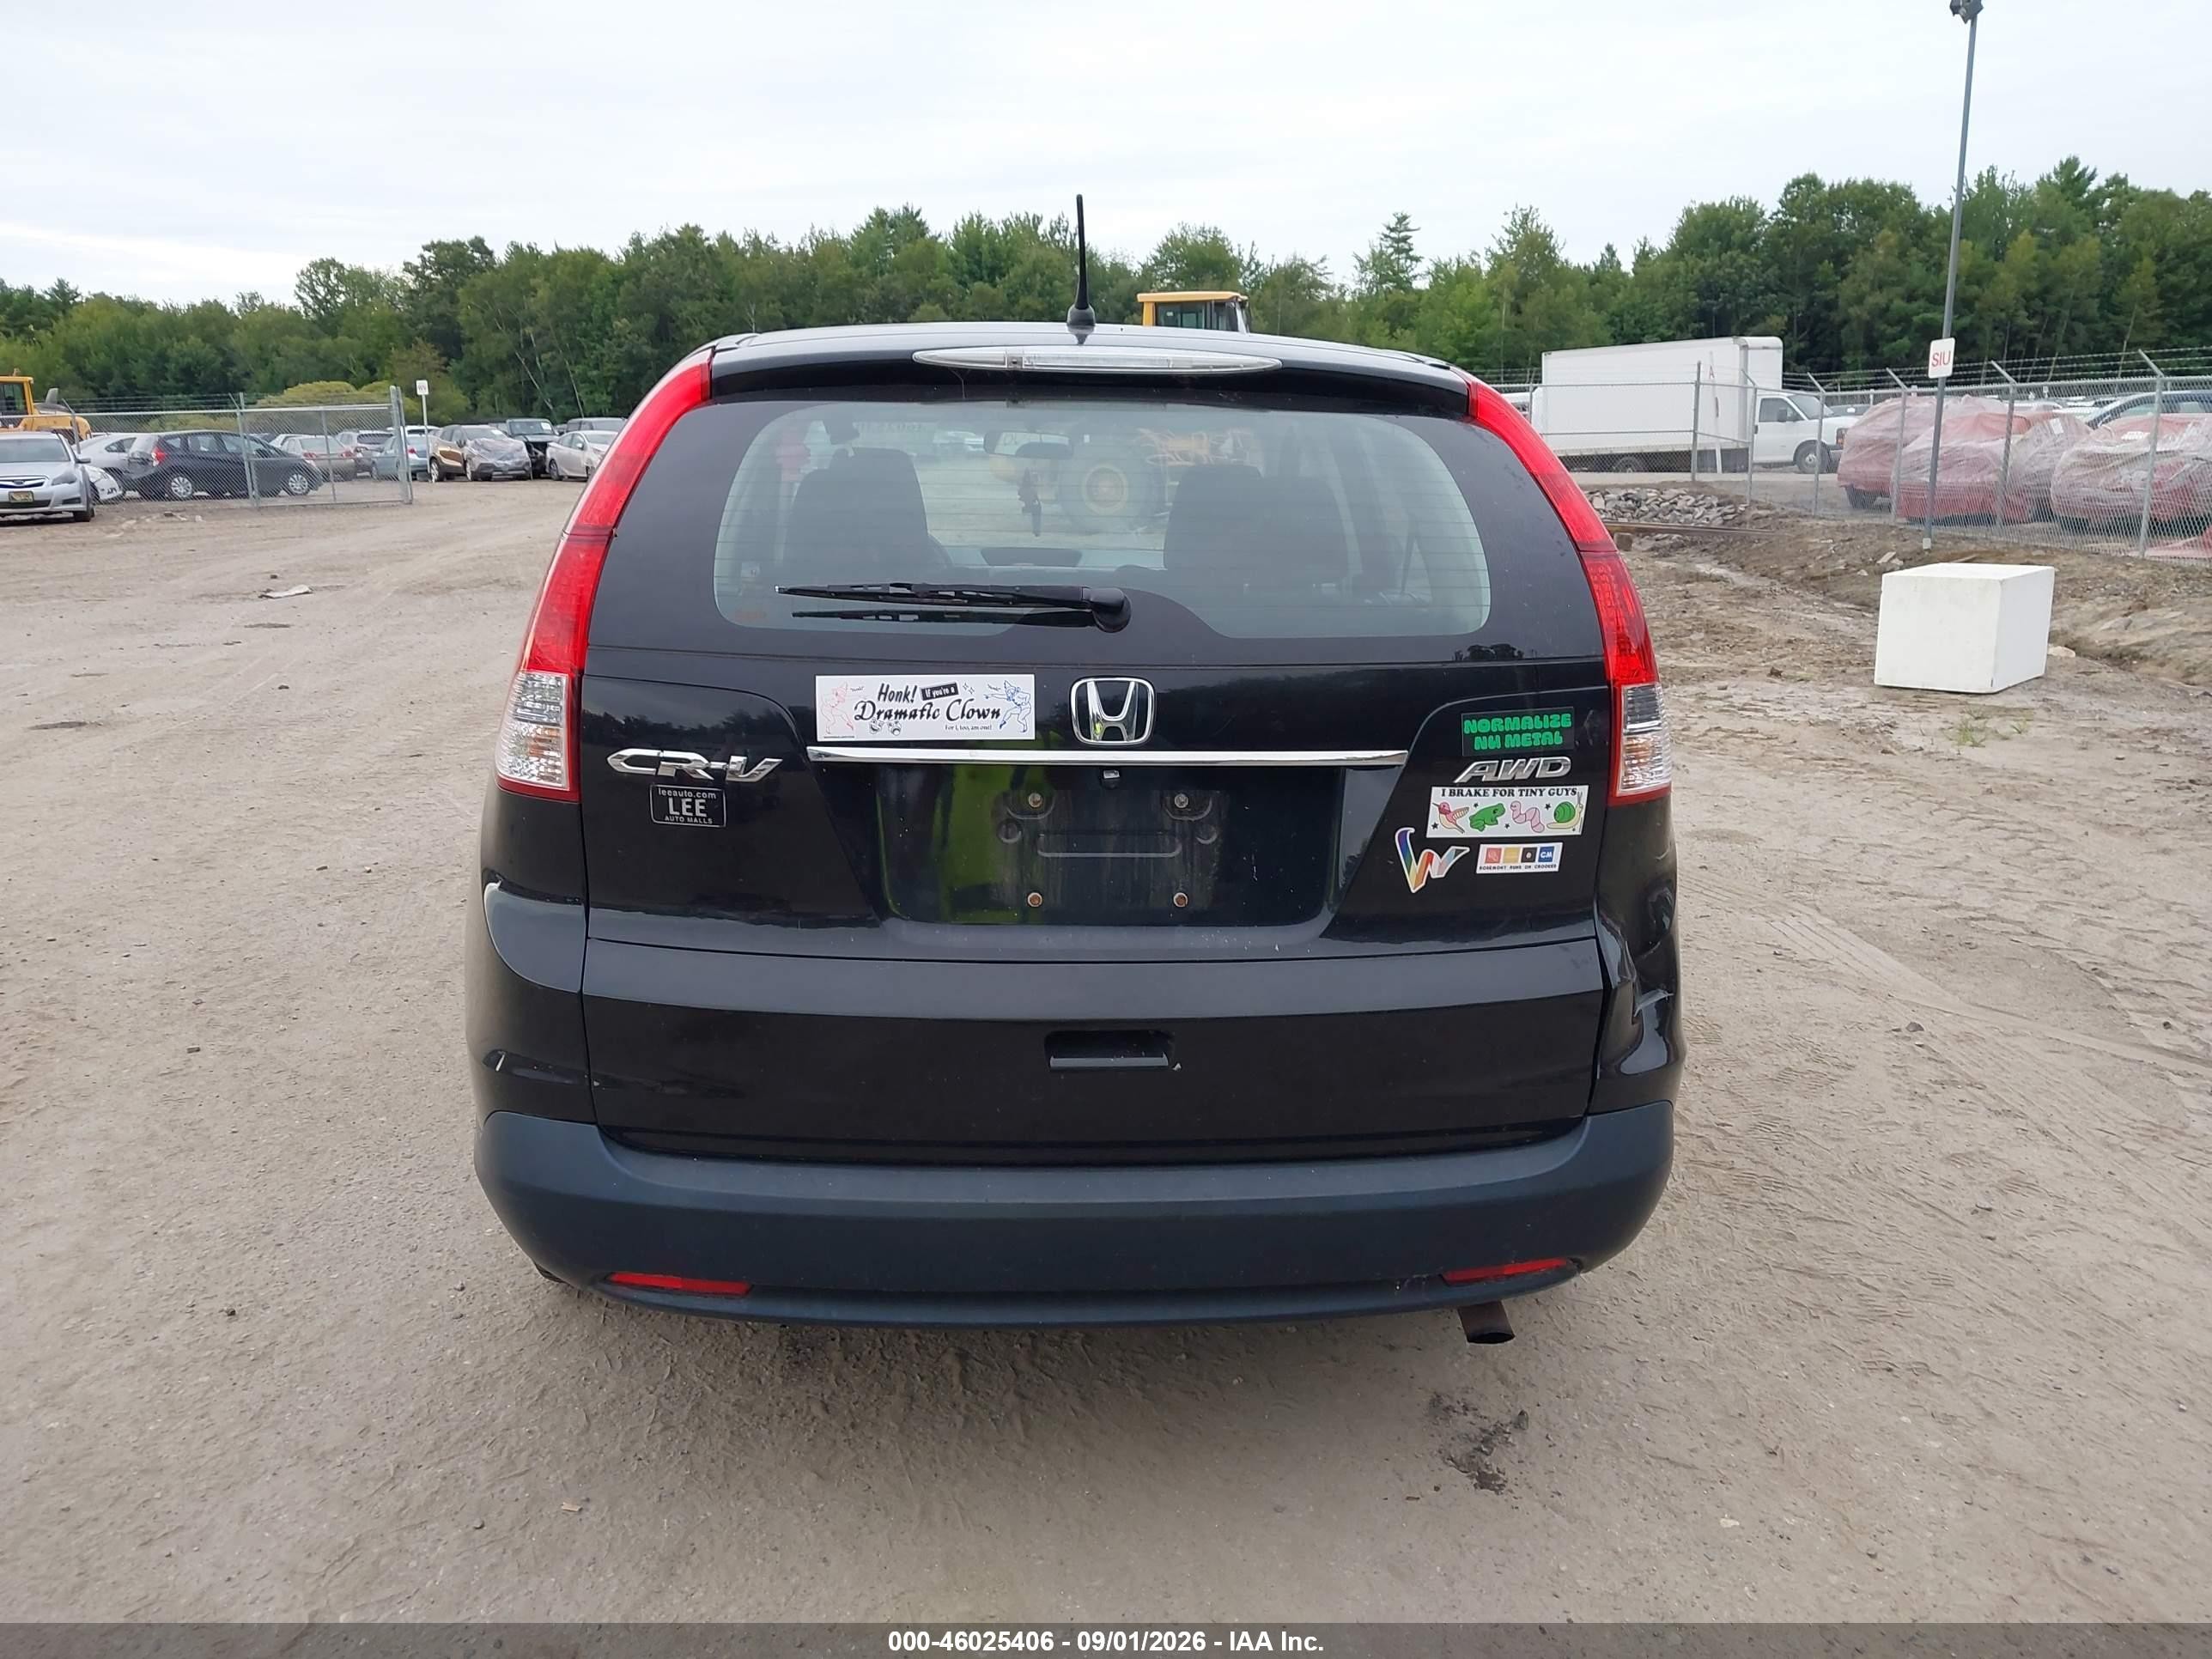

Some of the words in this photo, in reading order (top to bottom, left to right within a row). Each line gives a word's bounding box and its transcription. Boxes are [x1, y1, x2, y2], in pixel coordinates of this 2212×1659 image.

[1932, 350, 1952, 368] SIU
[878, 684, 918, 703] Honk!
[932, 686, 950, 698] you're
[854, 700, 940, 721] Dramatic
[945, 698, 1001, 721] Clown
[1463, 713, 1572, 734] NORMALIZE
[1474, 734, 1501, 750] NU
[1504, 731, 1563, 748] METAL
[606, 747, 783, 783] CR-V
[1453, 756, 1571, 783] AWD
[658, 787, 717, 799] leeauto.com
[1441, 788, 1446, 797] I
[1449, 787, 1490, 797] BRAKE
[1492, 787, 1515, 797] FOR
[1518, 787, 1547, 797] TINY
[1547, 787, 1577, 797] GUYS
[668, 797, 708, 817] LEE
